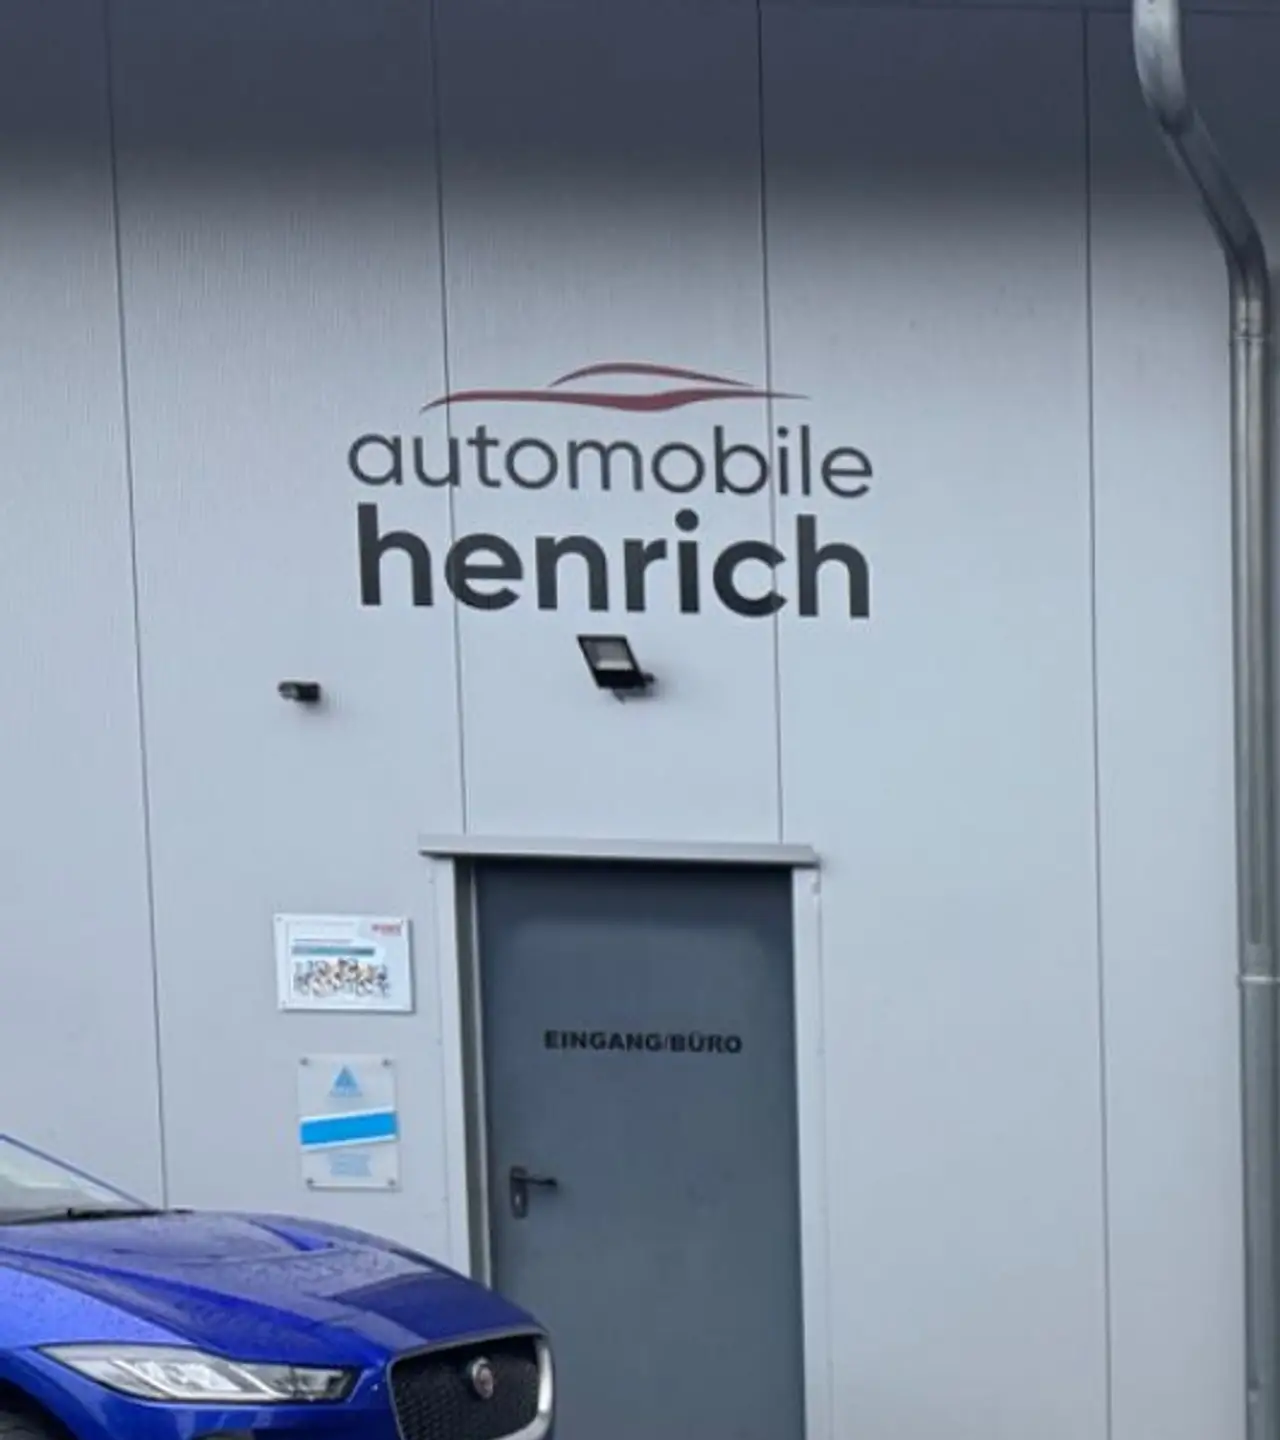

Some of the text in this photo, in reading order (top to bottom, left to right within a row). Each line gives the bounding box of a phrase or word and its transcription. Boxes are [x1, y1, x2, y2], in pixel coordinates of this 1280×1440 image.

[348, 424, 874, 498] automobile
[357, 503, 871, 618] henrich
[544, 1029, 743, 1054] EINGANG/BÜRO
